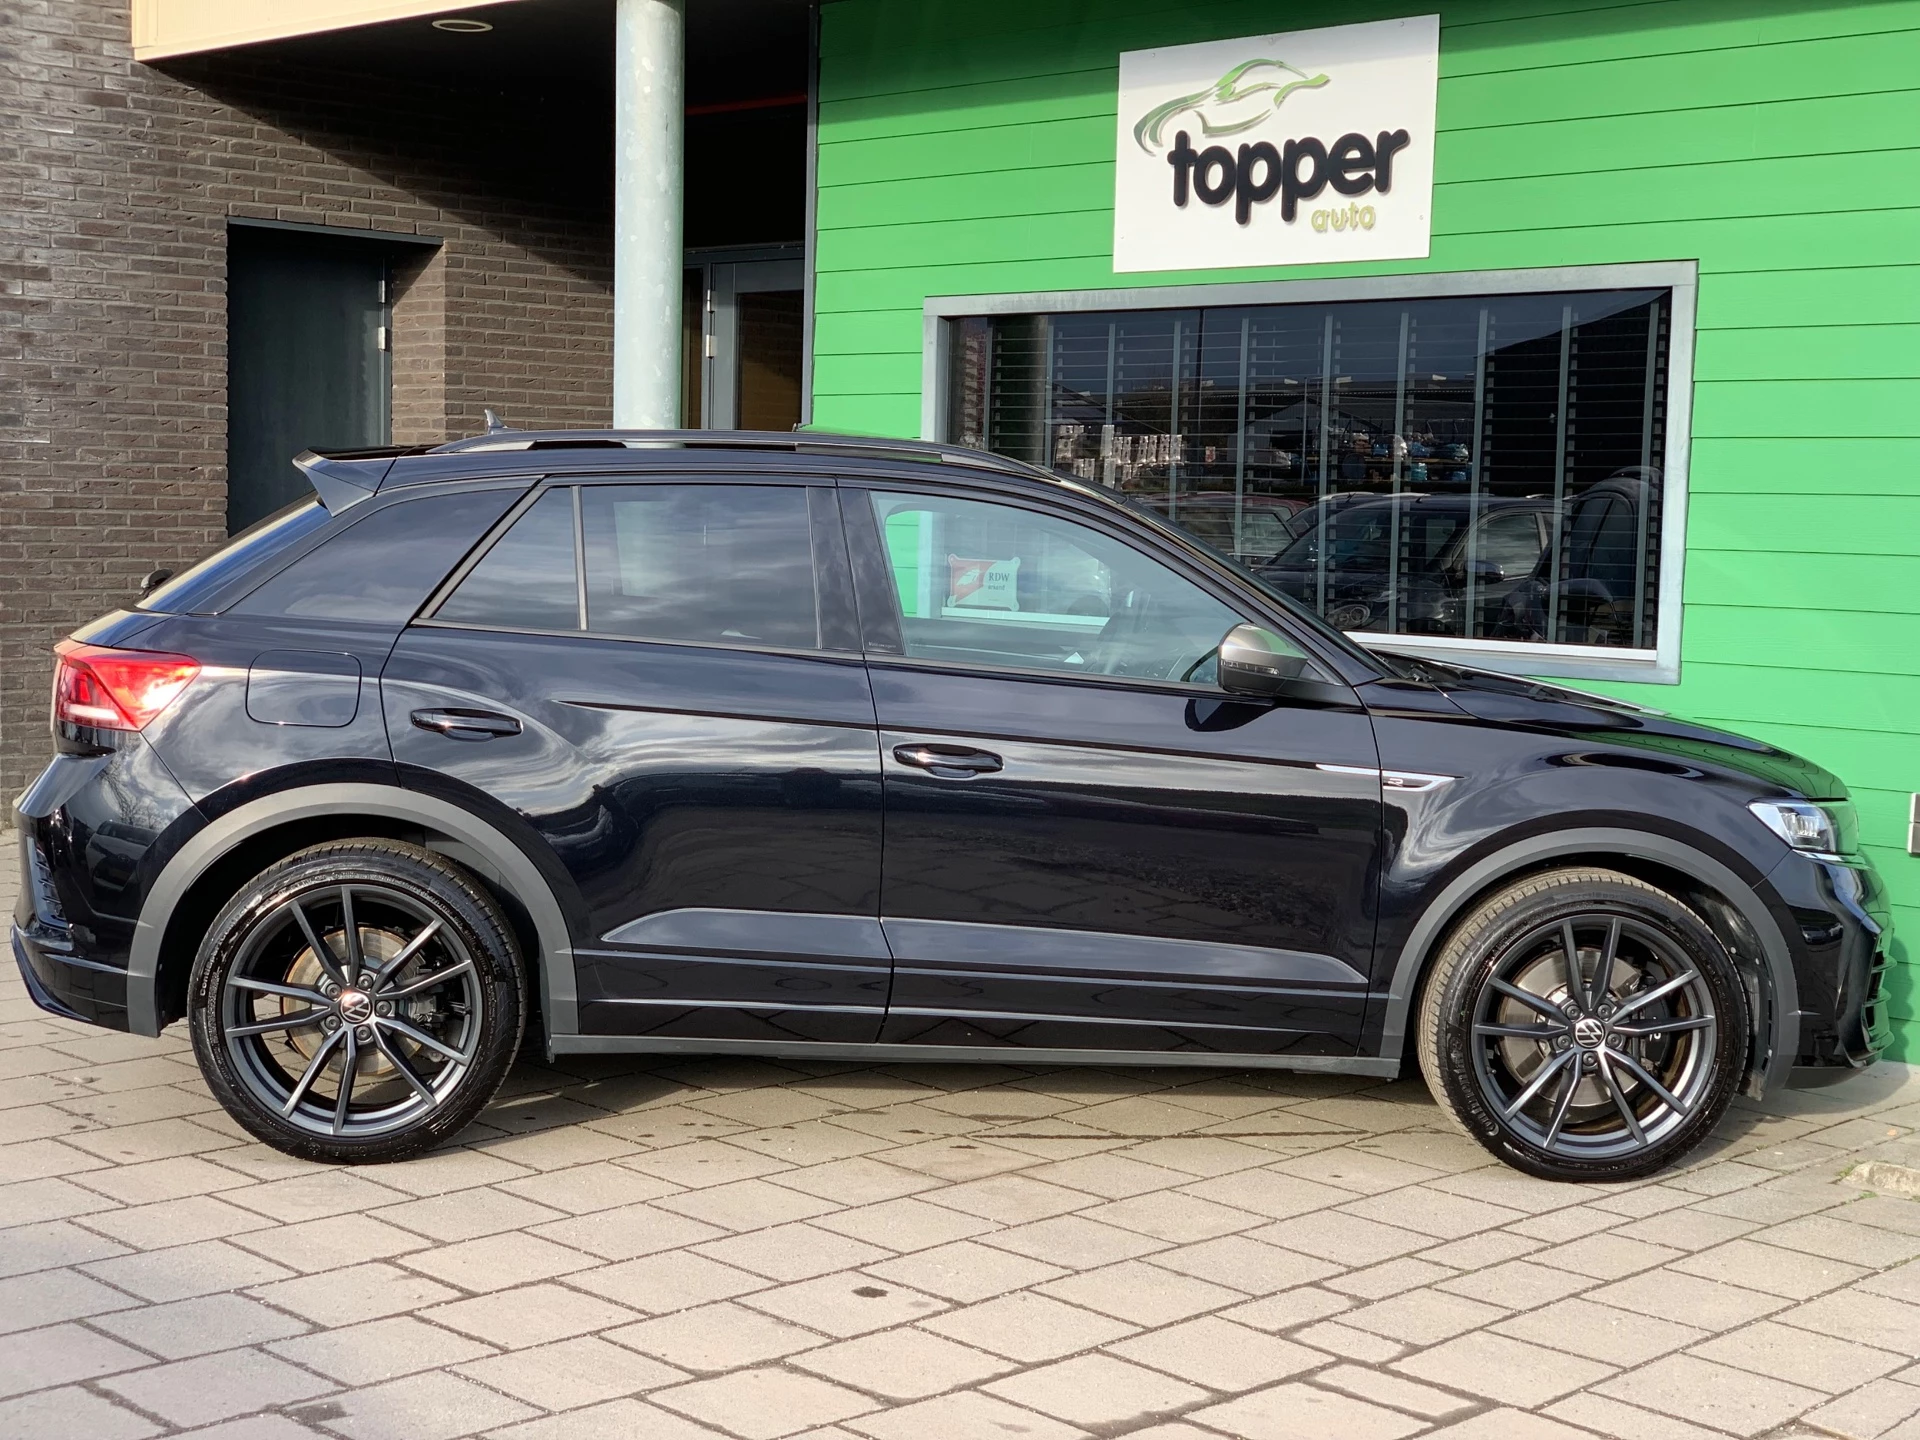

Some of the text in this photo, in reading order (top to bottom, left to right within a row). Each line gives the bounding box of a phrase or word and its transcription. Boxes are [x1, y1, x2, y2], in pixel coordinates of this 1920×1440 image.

[1167, 129, 1410, 225] topper
[1311, 202, 1376, 231] auto
[988, 572, 1010, 582] RDW
